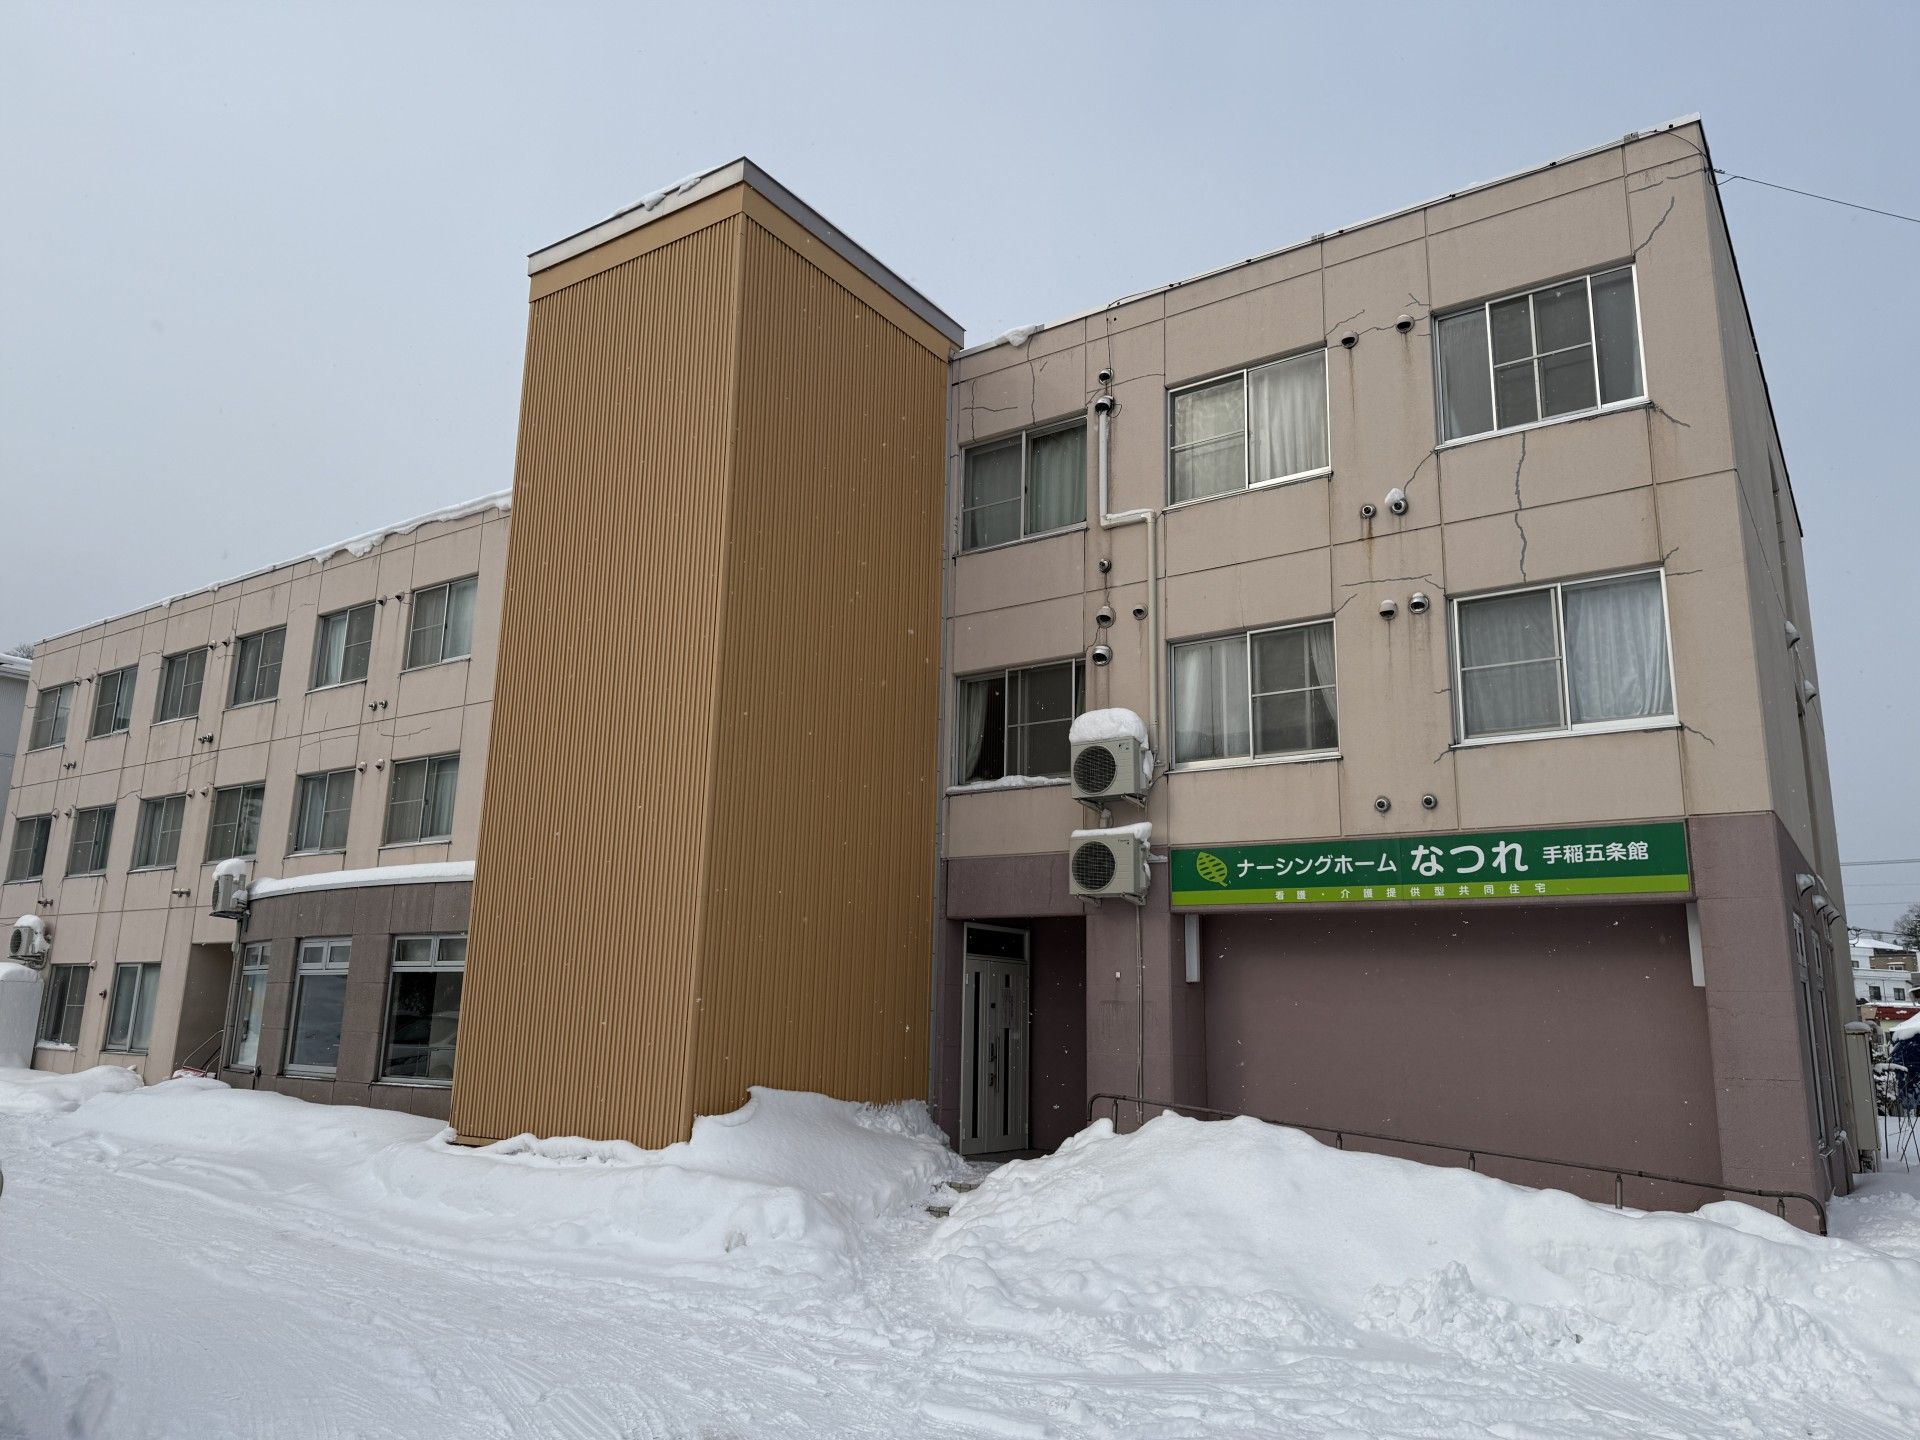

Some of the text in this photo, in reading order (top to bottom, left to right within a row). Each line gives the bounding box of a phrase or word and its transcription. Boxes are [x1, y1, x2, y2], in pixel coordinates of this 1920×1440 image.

[1236, 841, 1649, 878] ナーシングホーム なつれ 手稲五条館
